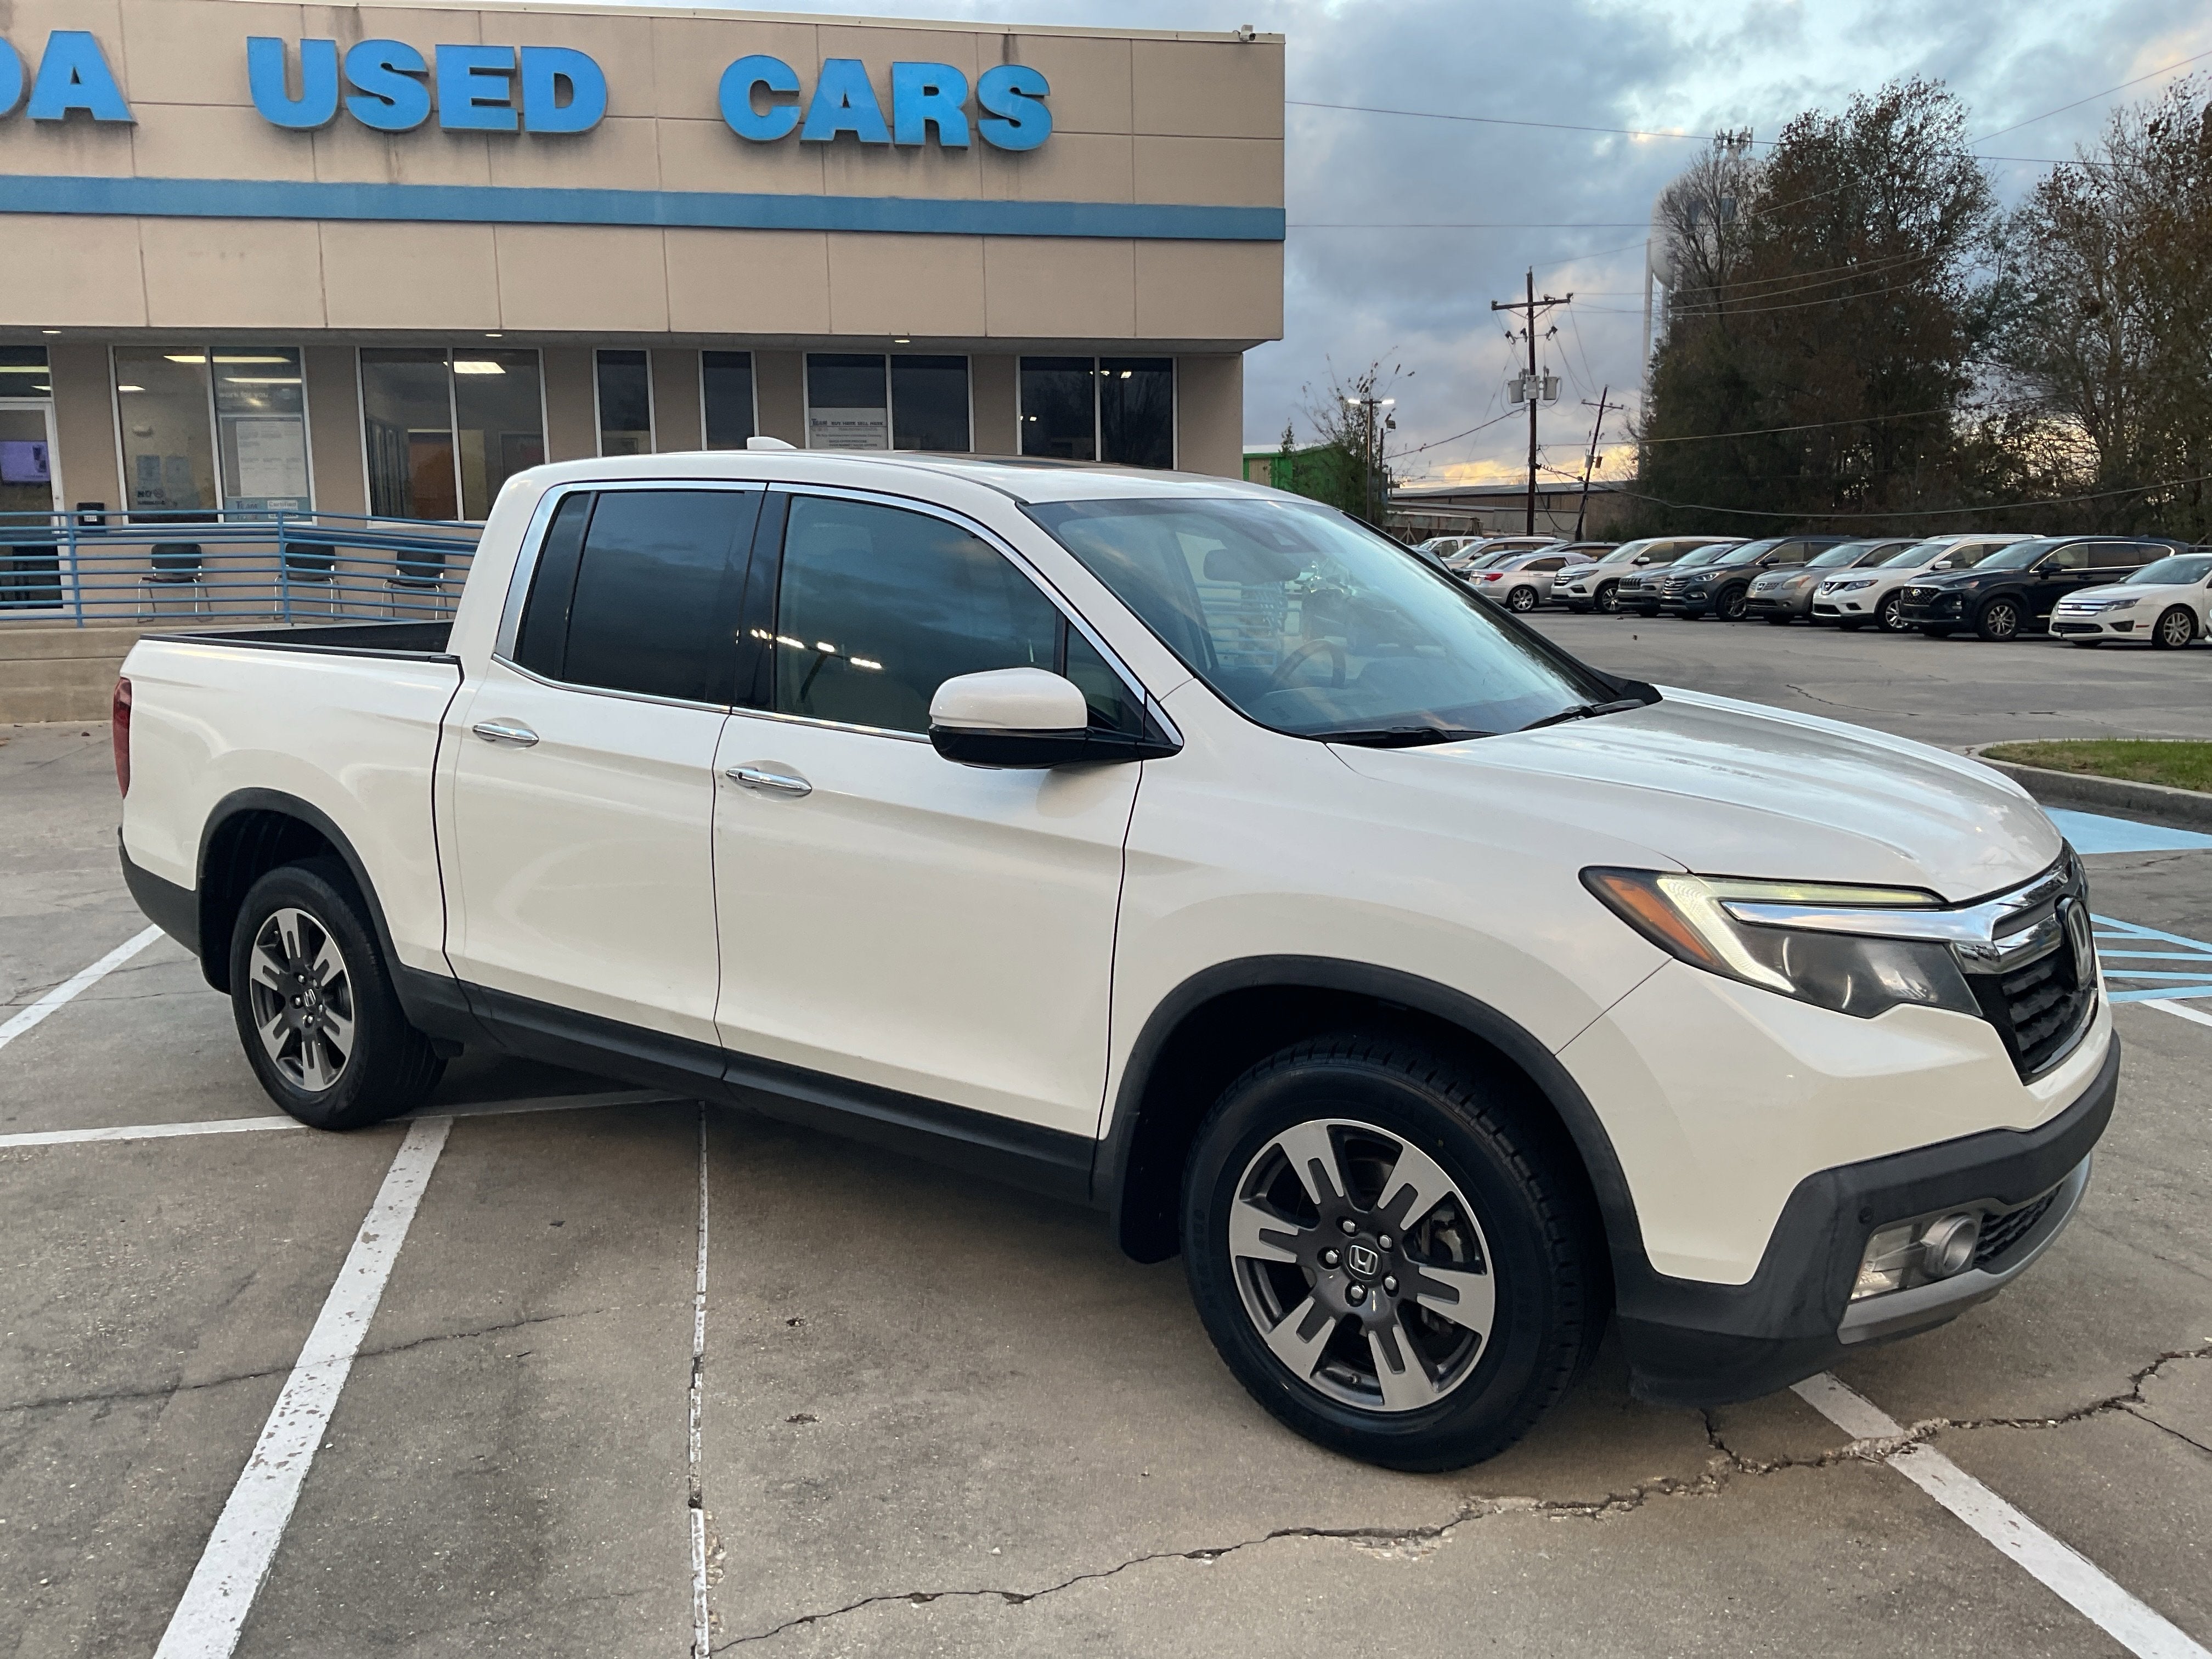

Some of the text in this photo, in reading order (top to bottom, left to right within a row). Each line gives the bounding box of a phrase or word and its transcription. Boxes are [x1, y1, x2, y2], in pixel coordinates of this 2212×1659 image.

[0, 30, 1053, 151] A USED CARS
